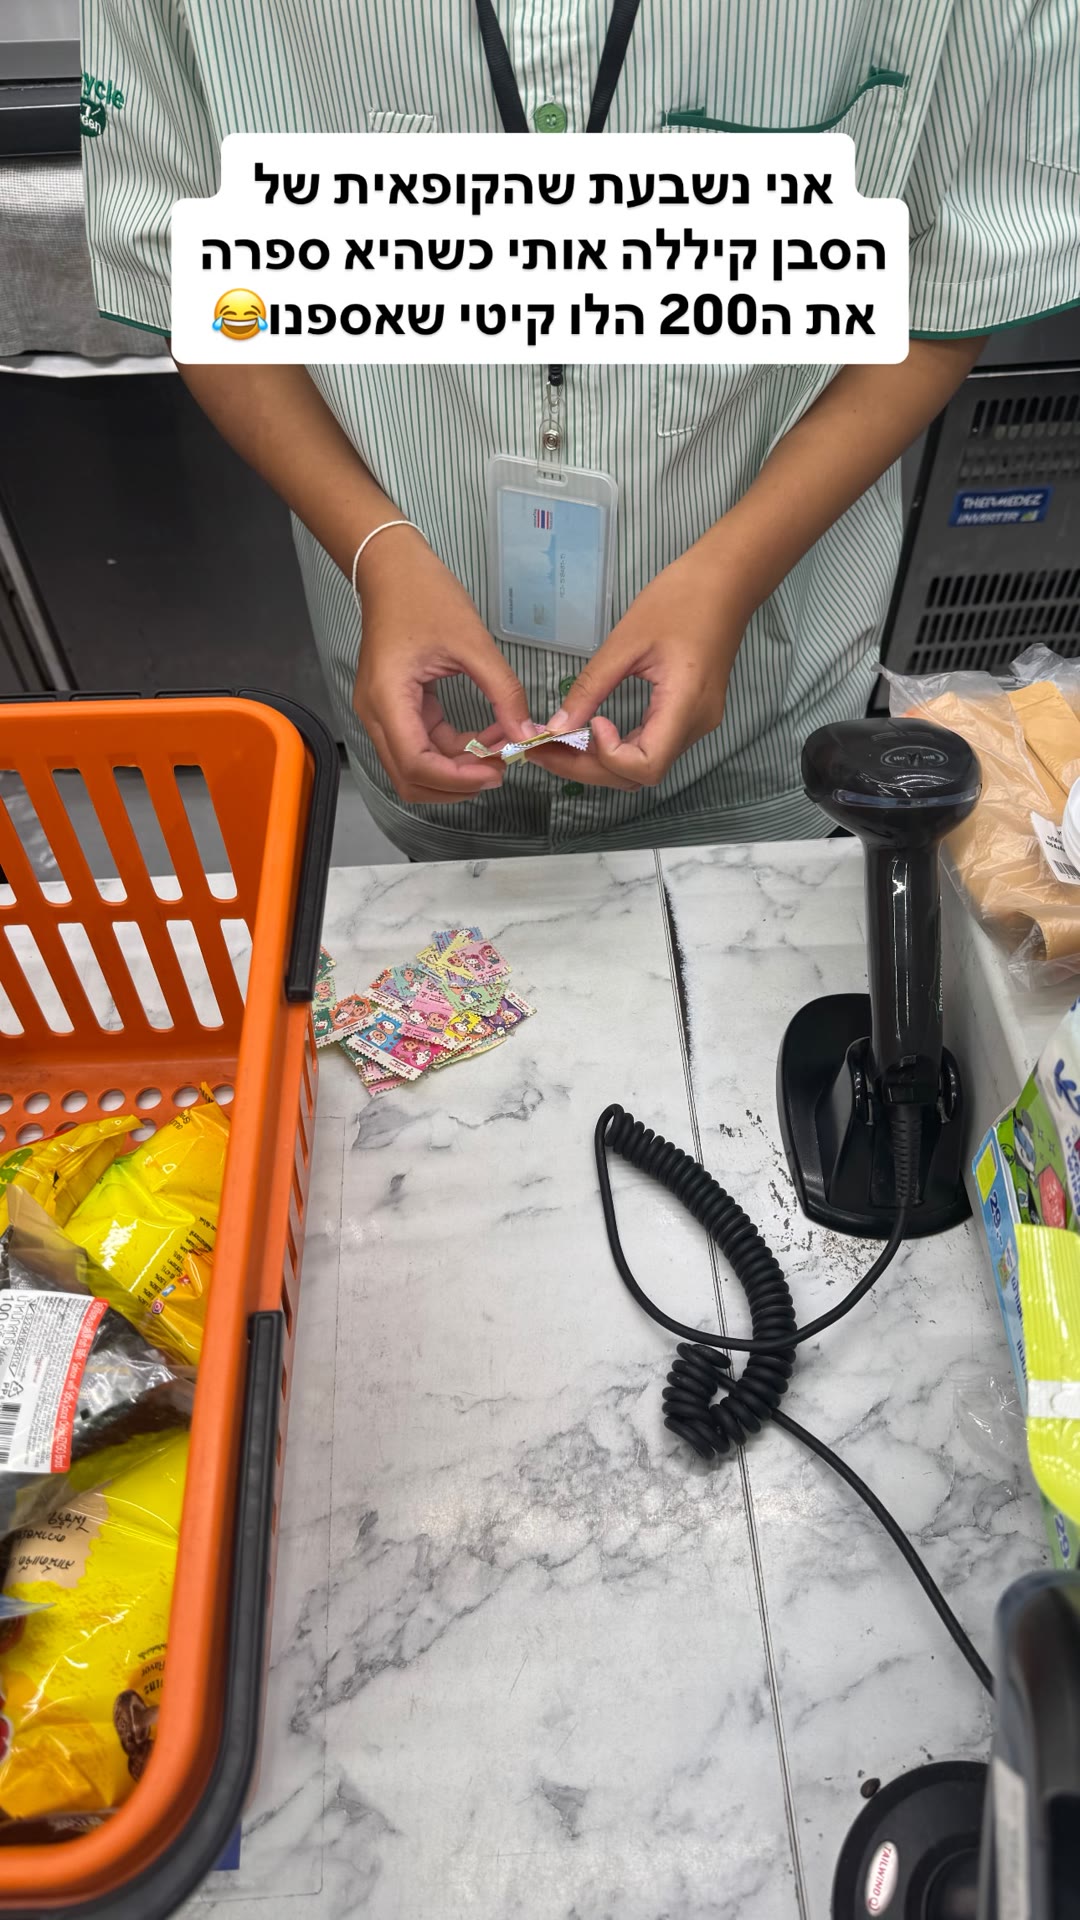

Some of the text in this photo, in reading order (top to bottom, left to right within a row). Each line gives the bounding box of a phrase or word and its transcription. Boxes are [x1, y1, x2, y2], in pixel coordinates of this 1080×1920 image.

[81, 72, 125, 110] ycle
[957, 512, 1019, 524] INVERTER
[873, 1847, 892, 1897] TAILWIND
